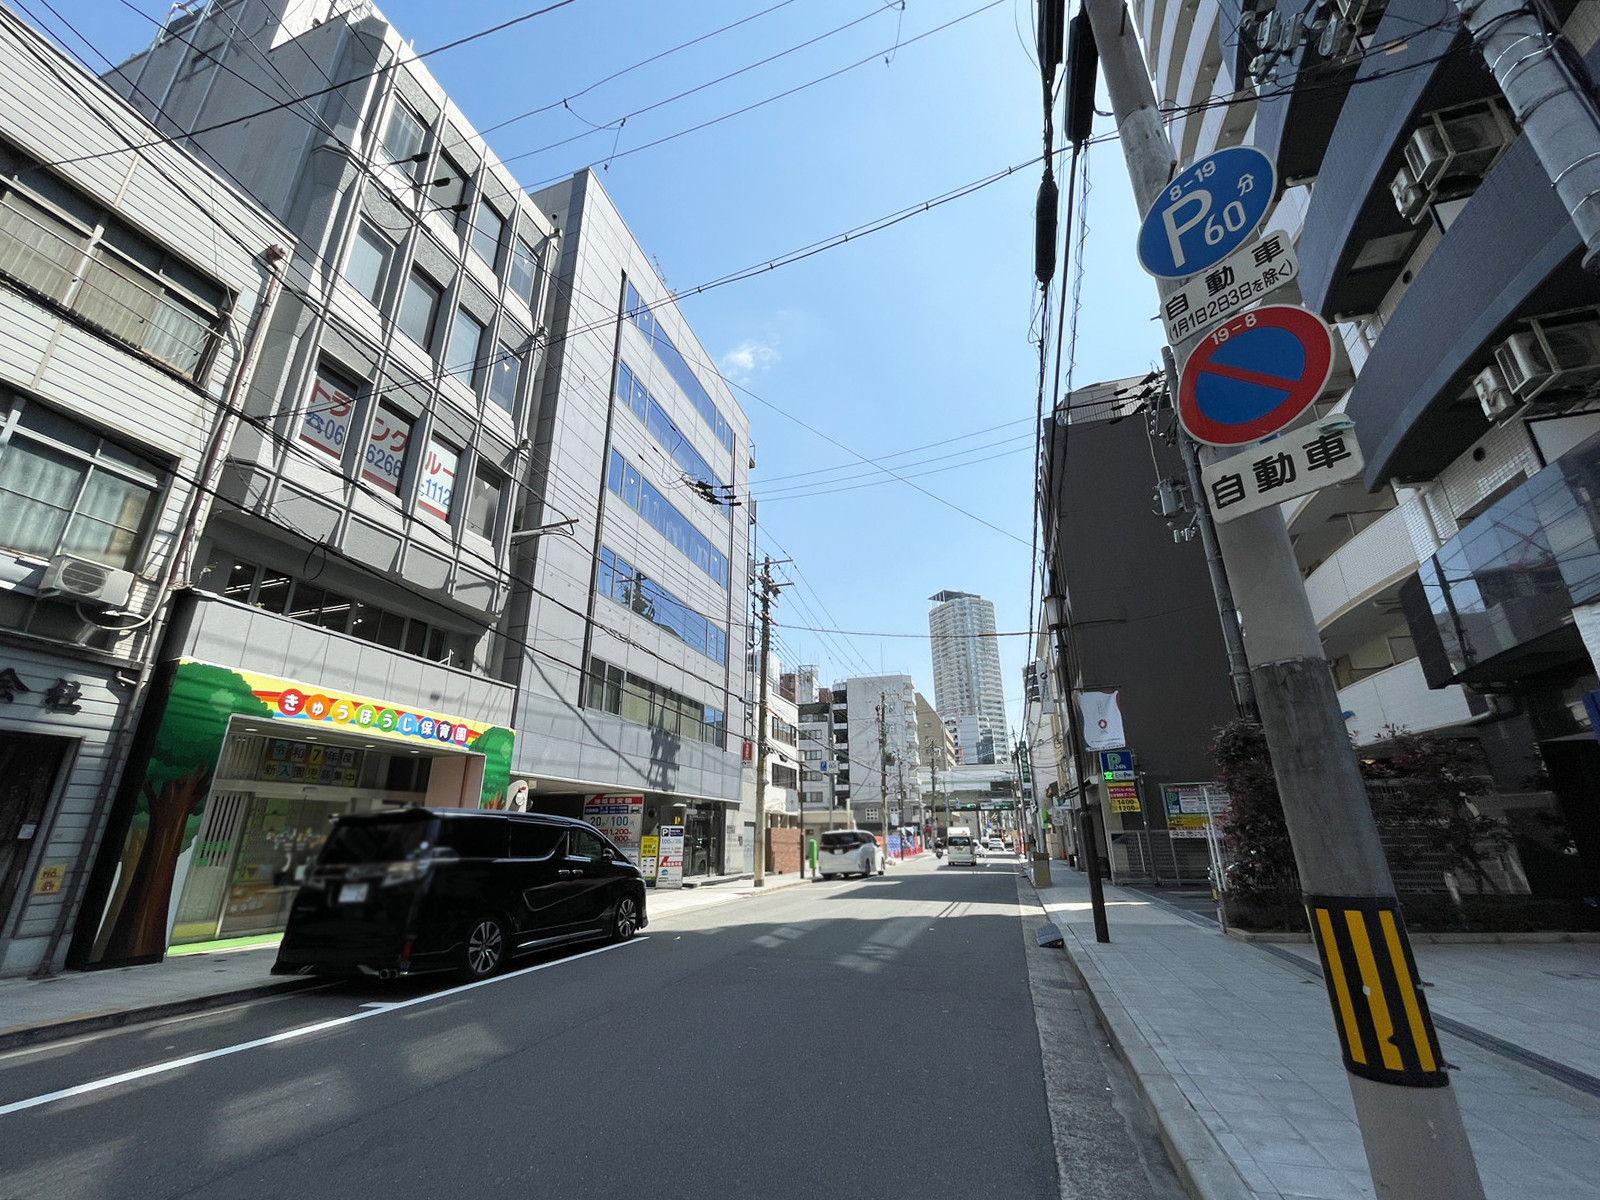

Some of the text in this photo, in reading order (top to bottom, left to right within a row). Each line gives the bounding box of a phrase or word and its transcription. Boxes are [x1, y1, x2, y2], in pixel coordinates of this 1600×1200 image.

[1169, 159, 1216, 201] 8-19
[1236, 173, 1255, 198] 分
[1161, 187, 1212, 268] P
[1203, 200, 1246, 247] 60
[1165, 235, 1285, 321] 自動車
[1211, 313, 1257, 345] 19-8
[1211, 431, 1352, 510] 自動車
[281, 690, 469, 742] きゅうほうじ保育園
[275, 743, 354, 764] 令和7年度
[1107, 753, 1121, 770] P
[611, 816, 629, 826] 100
